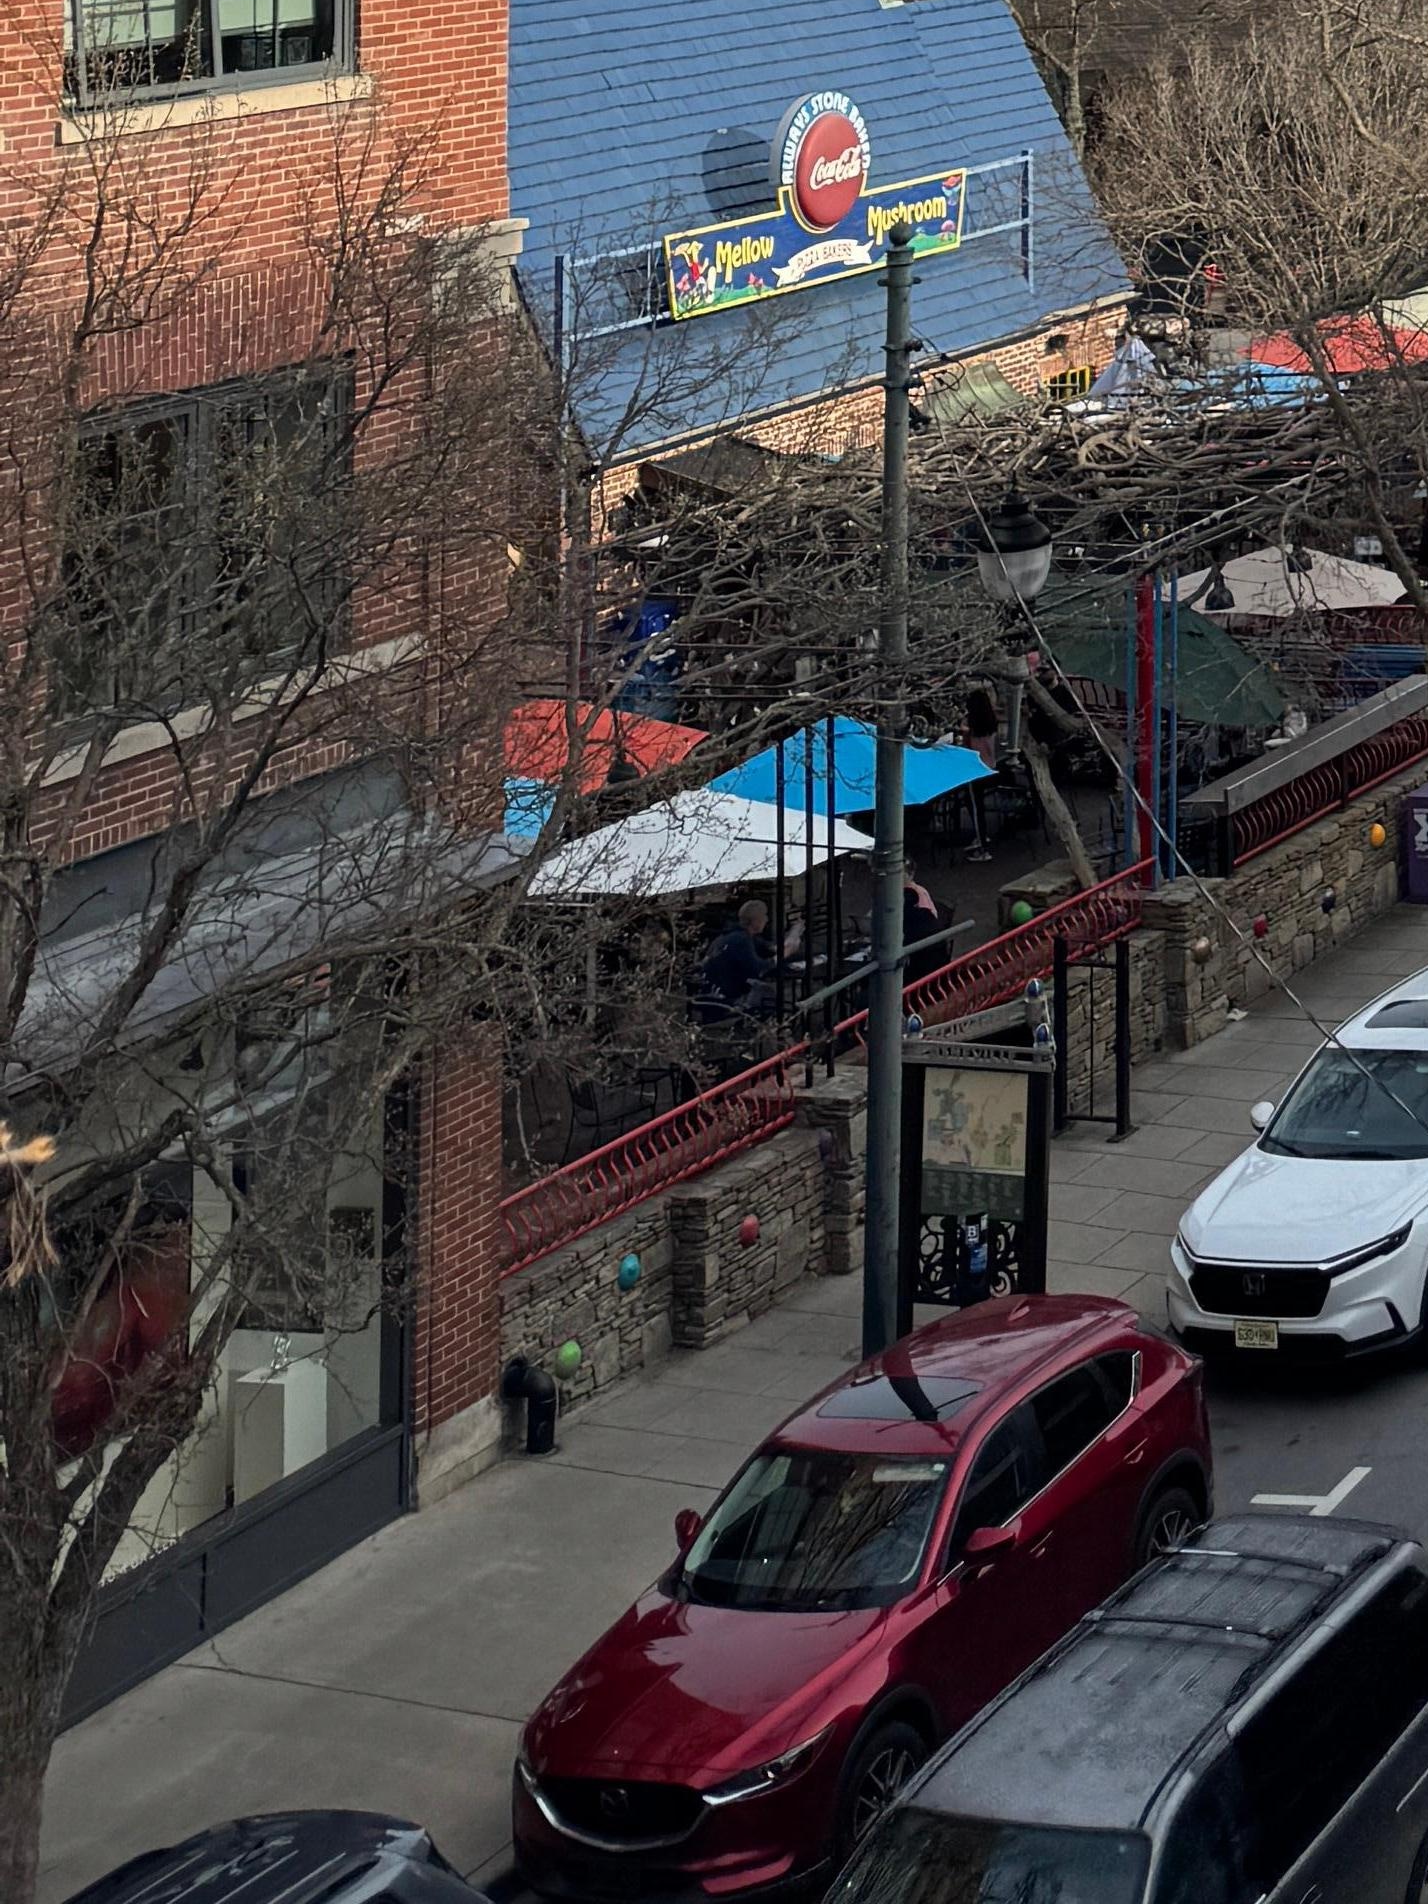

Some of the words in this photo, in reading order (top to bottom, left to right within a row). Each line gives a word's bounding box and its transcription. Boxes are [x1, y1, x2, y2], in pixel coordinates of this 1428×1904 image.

[781, 105, 811, 186] ALWAYS
[810, 91, 850, 116] STONE
[715, 236, 774, 284] Mellow
[867, 195, 947, 245] Mushroom
